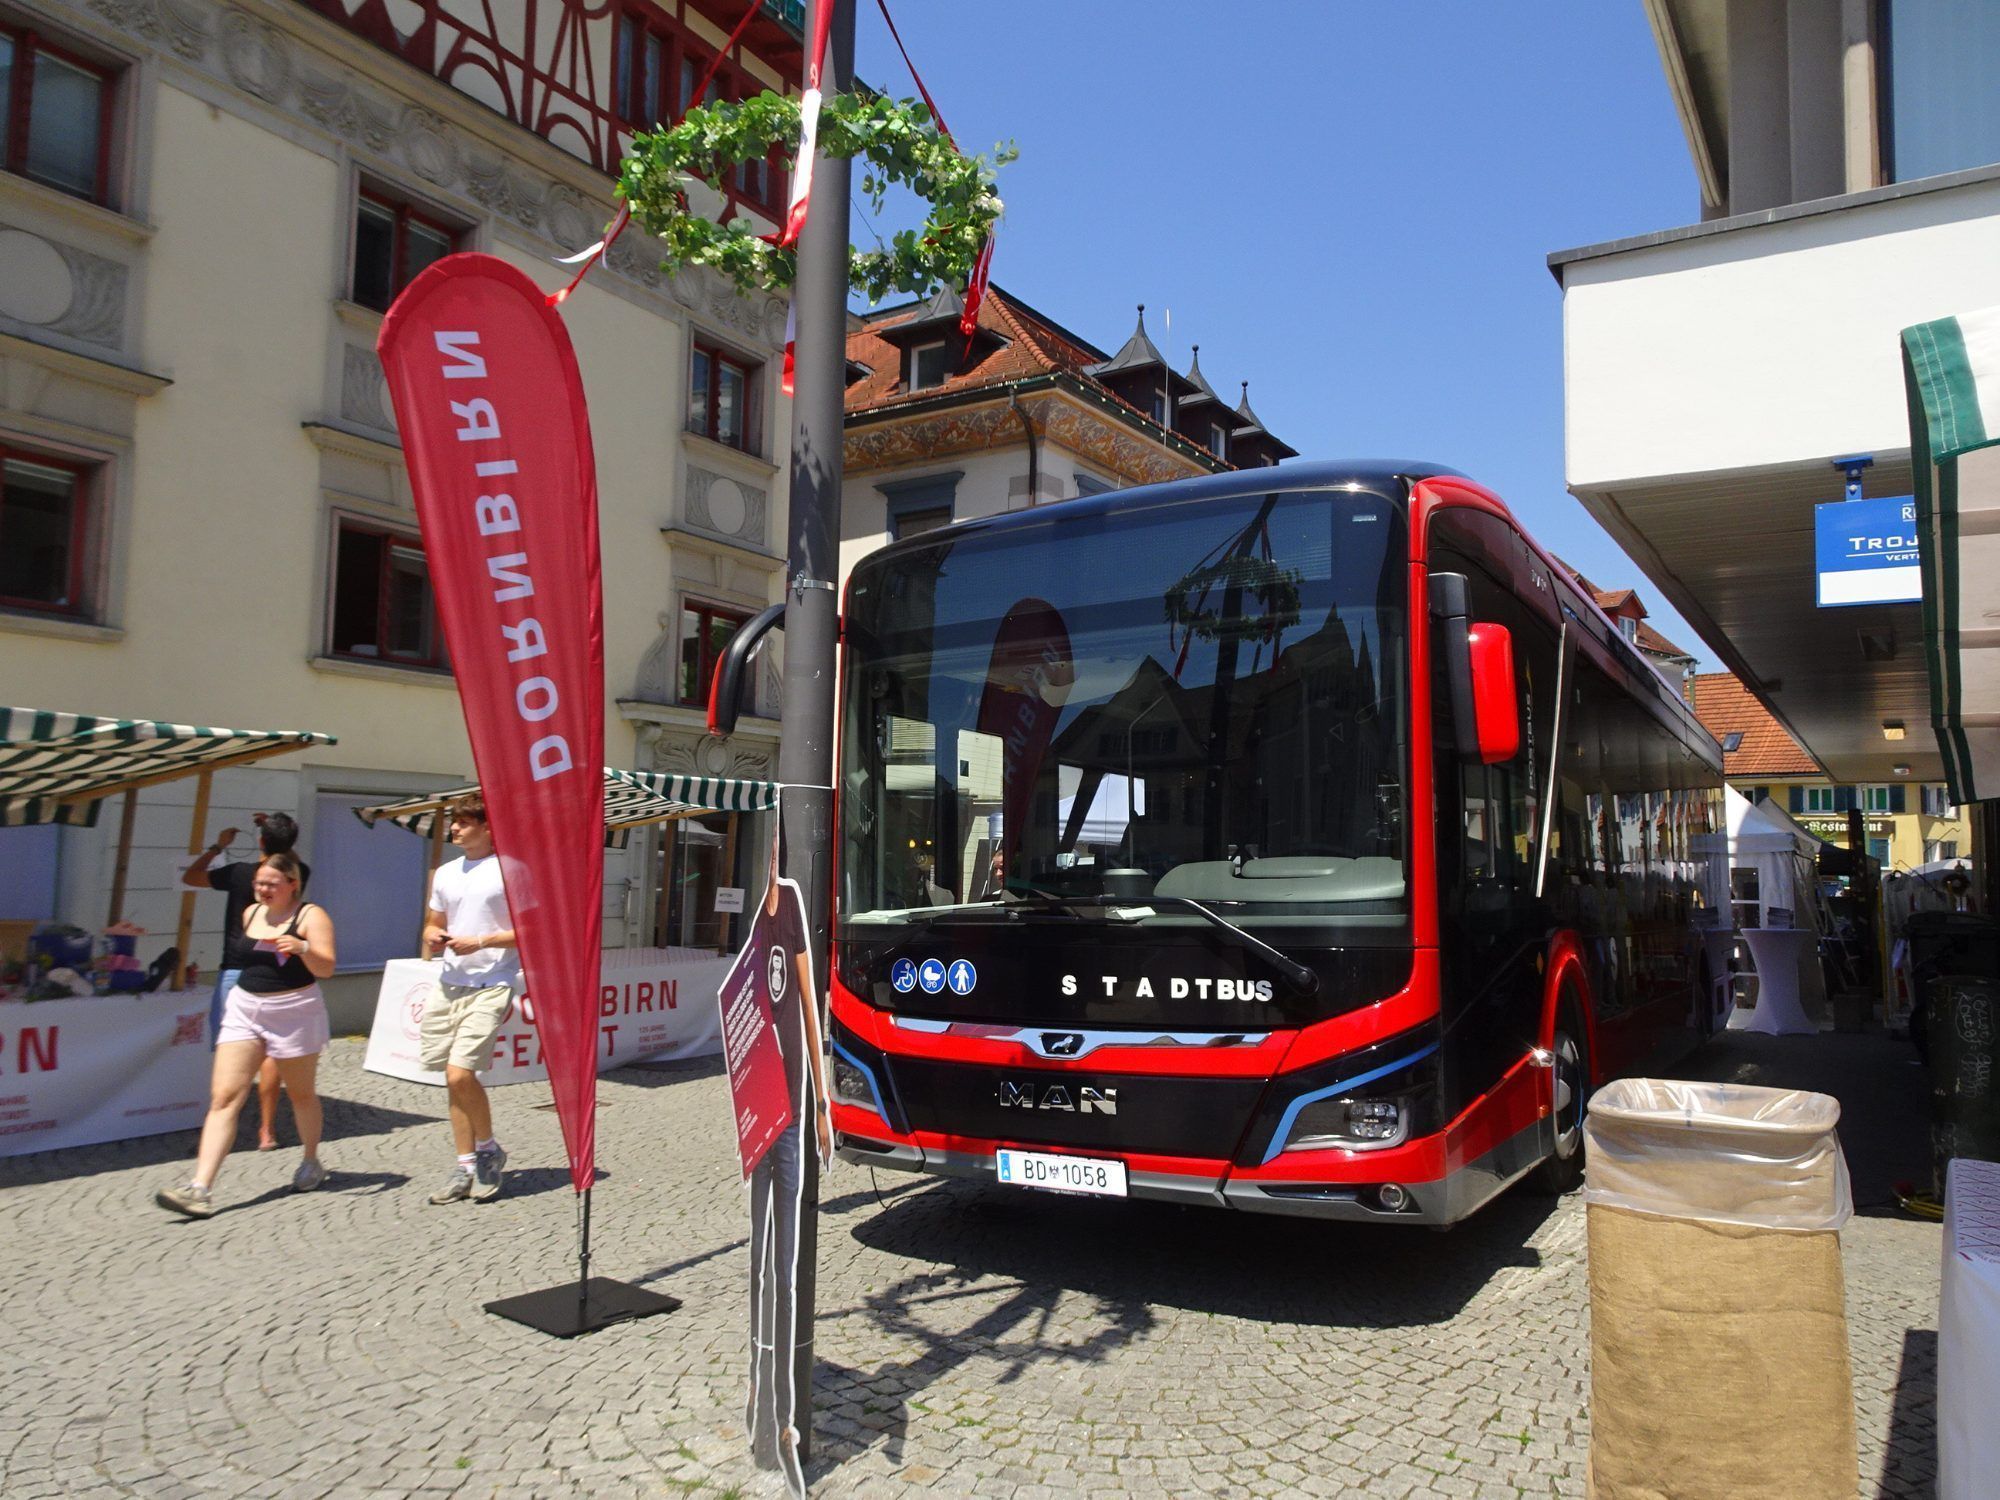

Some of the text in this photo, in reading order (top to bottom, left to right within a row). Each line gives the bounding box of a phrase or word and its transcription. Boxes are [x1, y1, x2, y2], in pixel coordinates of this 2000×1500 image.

[1902, 507, 1916, 519] R
[1808, 821, 1883, 832] Restant
[1000, 1081, 1117, 1115] MAN
